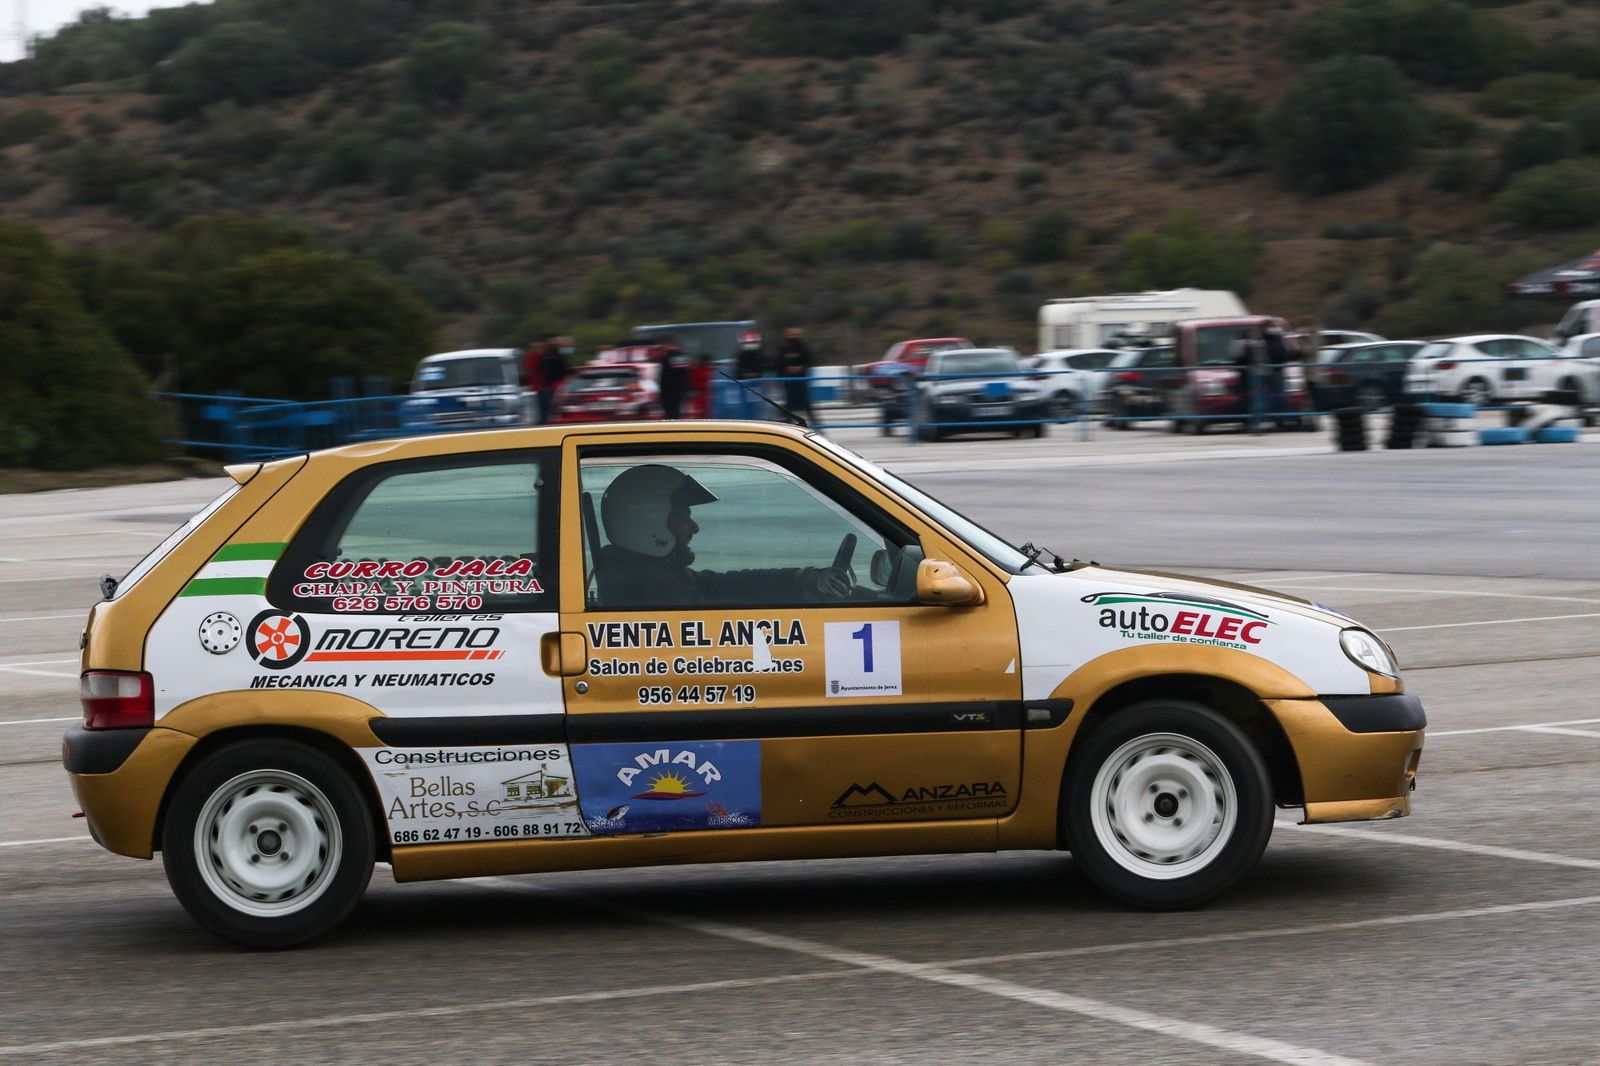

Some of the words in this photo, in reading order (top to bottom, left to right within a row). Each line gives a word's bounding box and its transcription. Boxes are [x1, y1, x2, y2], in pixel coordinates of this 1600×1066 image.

[304, 561, 429, 580] CURRO
[433, 558, 533, 577] JALA
[293, 582, 384, 597] CHAPA
[394, 581, 414, 595] Y
[424, 579, 544, 595] PINTURA
[333, 597, 378, 611] 626
[384, 596, 429, 611] 576
[436, 595, 482, 610] 570
[314, 627, 500, 650] MORENO
[587, 622, 673, 648] VENTA
[681, 621, 711, 647] EL
[1120, 630, 1134, 639] Tu
[1137, 630, 1170, 641] taller
[1172, 634, 1187, 643] de
[1189, 636, 1247, 650] confianza
[852, 623, 873, 673] 1
[589, 658, 640, 675] Salon
[645, 656, 668, 675] de
[250, 674, 348, 688] MECANICA
[354, 674, 367, 687] Y
[371, 672, 495, 687] NEUMATICOS
[639, 686, 672, 703] 956
[678, 686, 700, 703] 44
[705, 686, 727, 702] 57
[733, 685, 755, 702] 19
[953, 713, 985, 721] VTS
[375, 748, 560, 764] Construcciones
[616, 749, 722, 787] AMAR
[410, 775, 475, 797] Bellas
[388, 796, 463, 820] Artes,
[828, 805, 935, 819] CONSTRUCCIONES
[937, 804, 944, 812] Y
[949, 799, 1008, 811] REFORMAS
[394, 830, 419, 843] 686
[423, 828, 440, 841] 62
[444, 828, 460, 840] 47
[464, 826, 481, 838] 19
[493, 824, 519, 837] 606
[523, 823, 540, 836] 88
[543, 822, 559, 835] 91
[564, 822, 581, 834] 72
